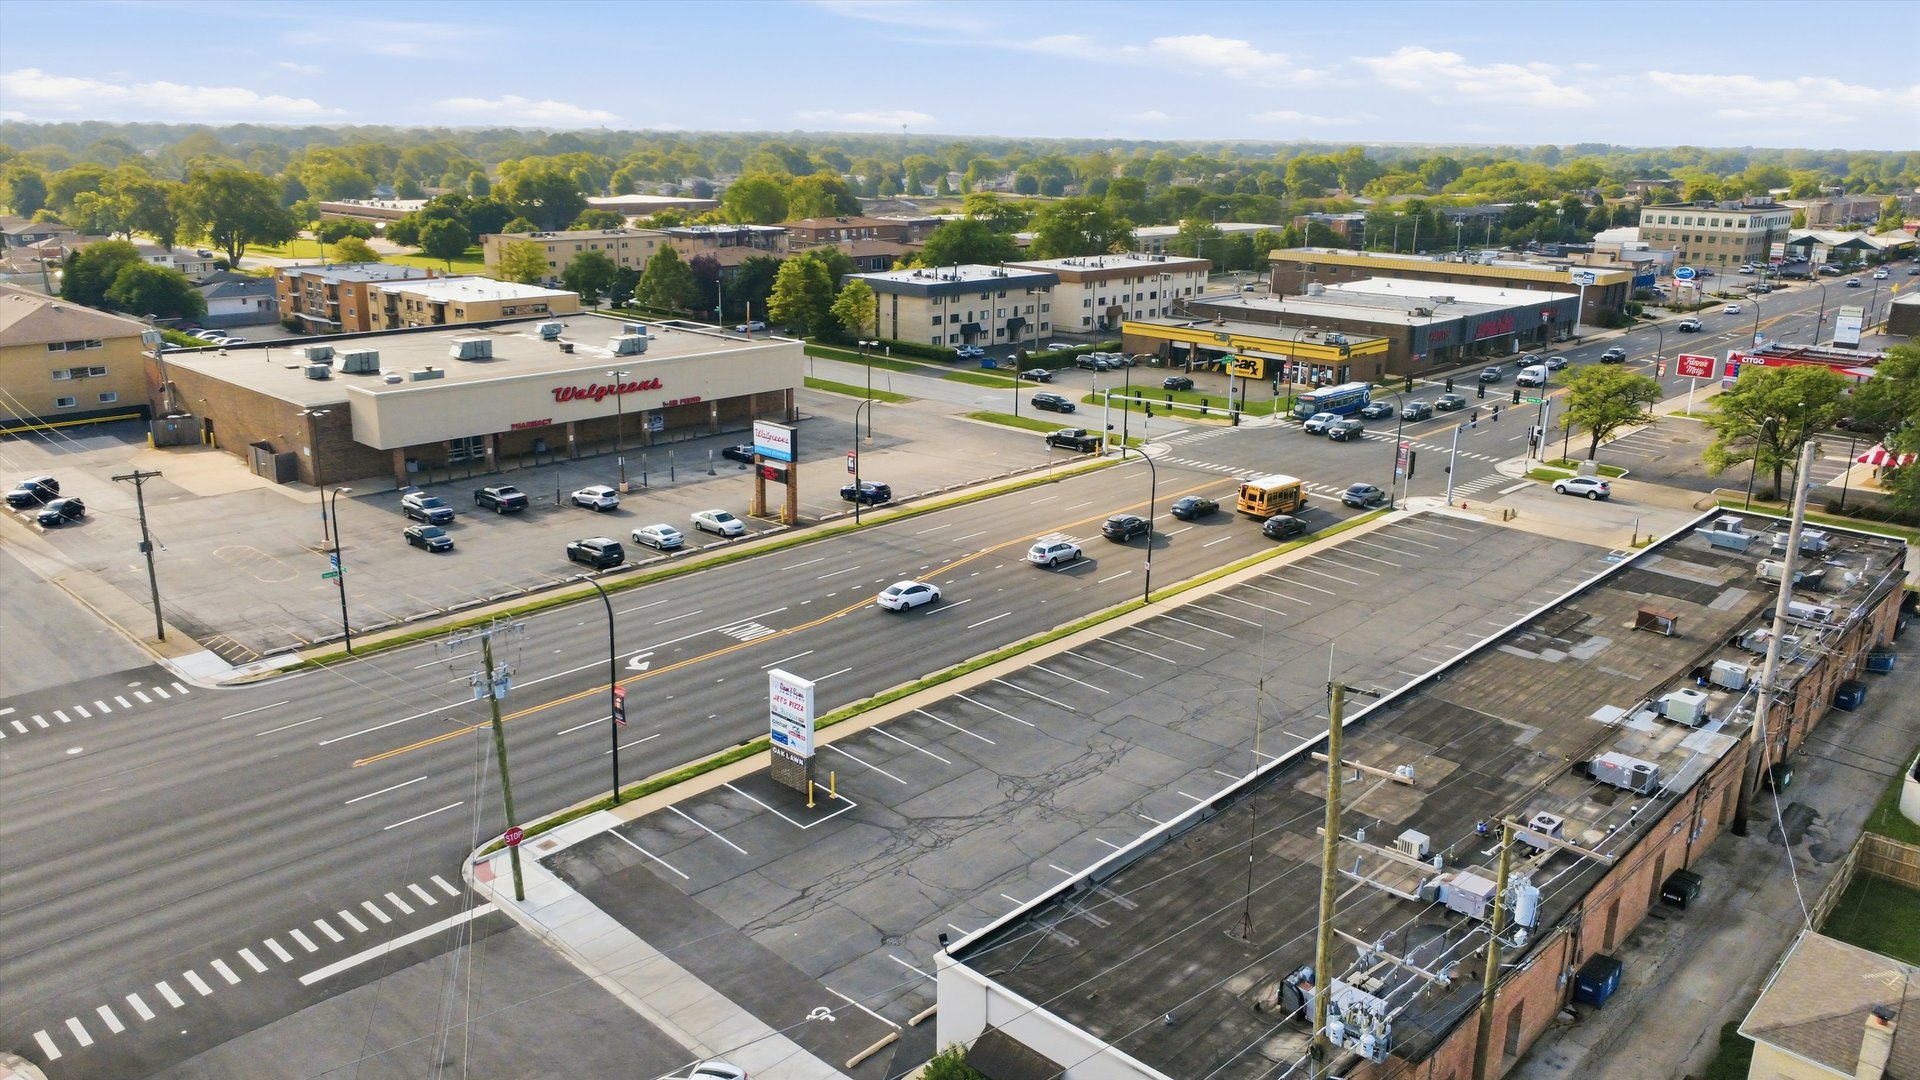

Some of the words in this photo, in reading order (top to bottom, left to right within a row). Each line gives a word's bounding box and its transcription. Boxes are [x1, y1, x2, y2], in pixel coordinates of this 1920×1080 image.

[1684, 357, 1709, 368] Fannie
[1742, 357, 1765, 365] CITGO
[1686, 365, 1705, 376] May
[552, 377, 663, 403] Walgreens
[511, 418, 552, 431] PHARMACY
[755, 428, 789, 445] Walgreens
[788, 700, 804, 712] PIZZA
[772, 746, 785, 758] OAK
[785, 752, 804, 766] LAWN
[505, 830, 523, 843] STOP
